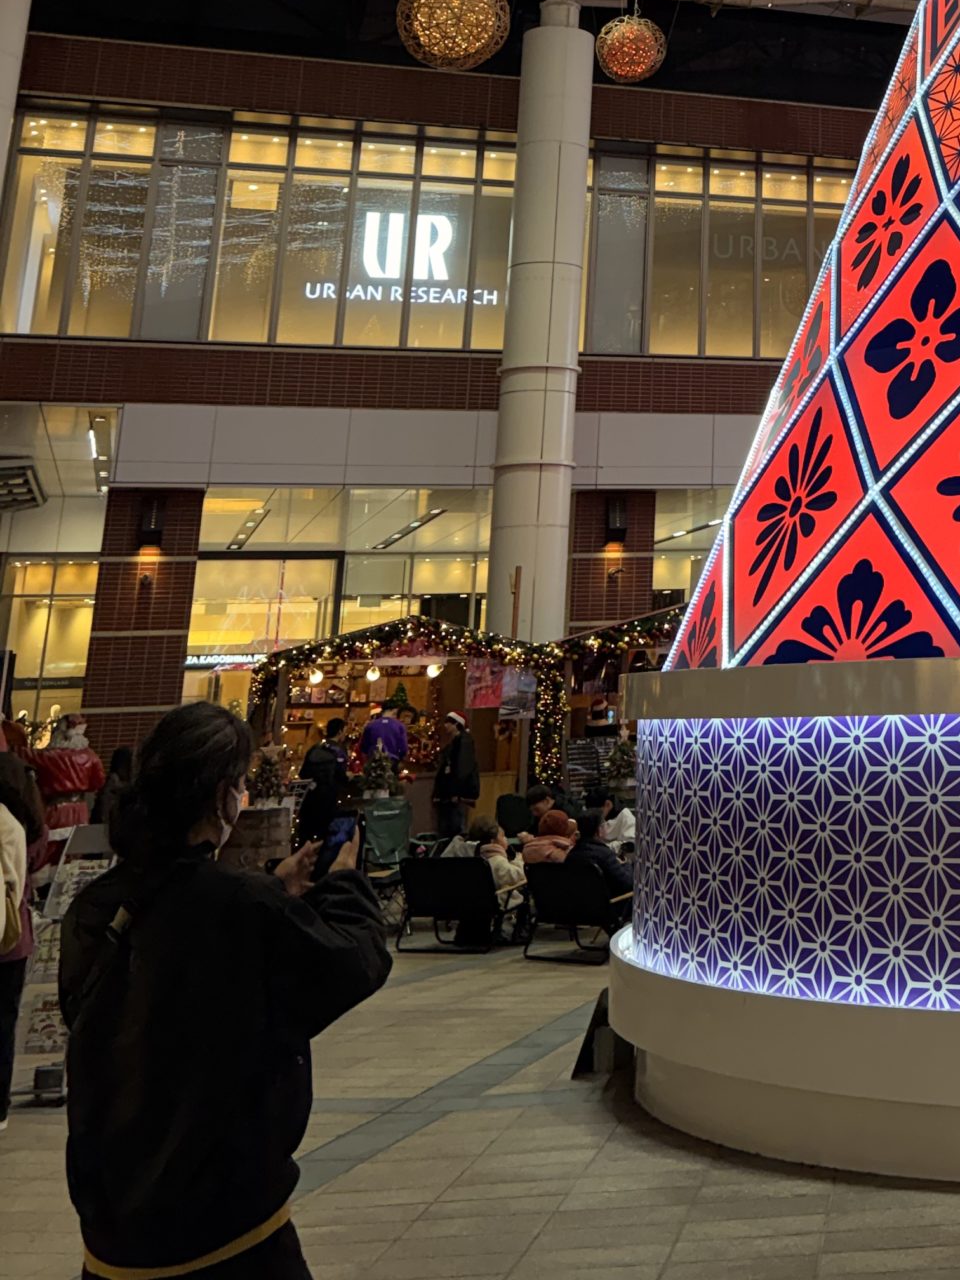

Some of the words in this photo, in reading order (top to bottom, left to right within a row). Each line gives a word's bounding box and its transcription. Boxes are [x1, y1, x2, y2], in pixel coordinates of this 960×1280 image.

[363, 211, 453, 281] UR
[305, 282, 384, 301] URAN
[199, 654, 253, 665] KAGOSHIMA
